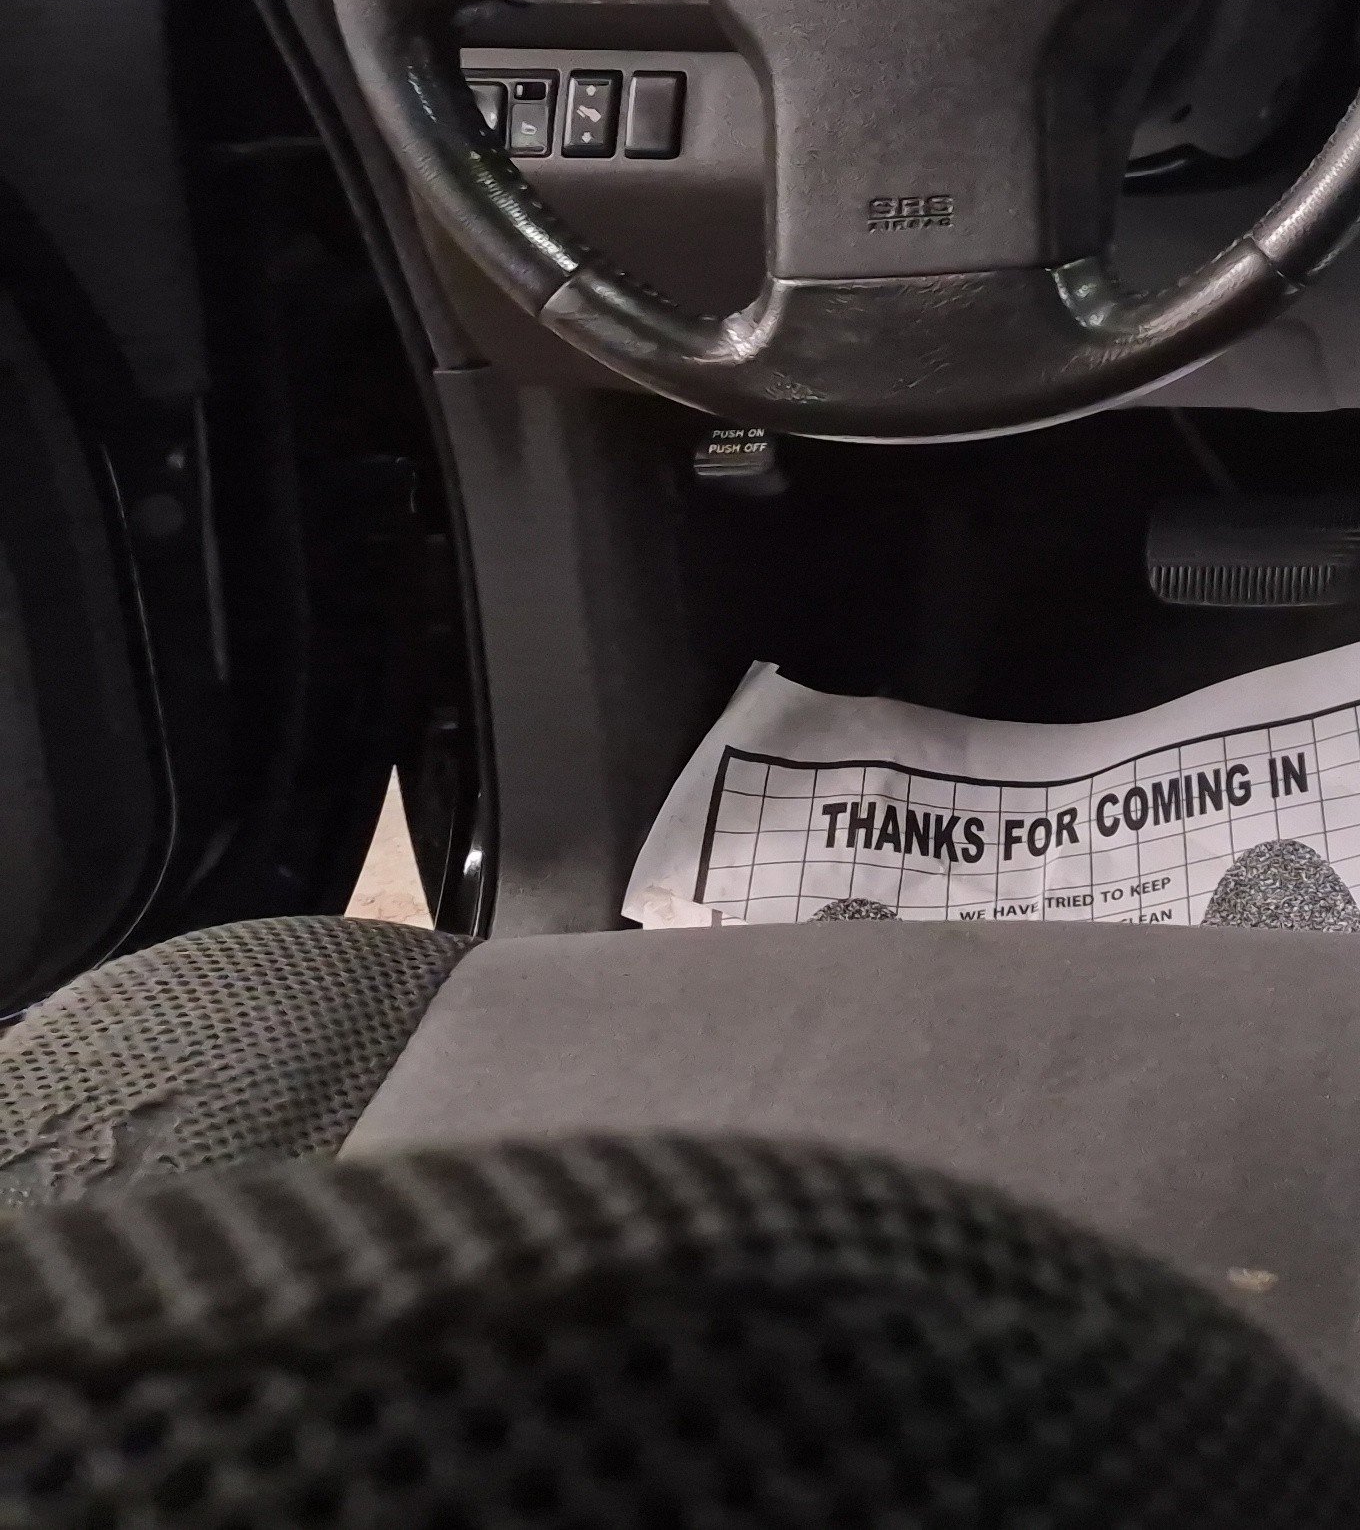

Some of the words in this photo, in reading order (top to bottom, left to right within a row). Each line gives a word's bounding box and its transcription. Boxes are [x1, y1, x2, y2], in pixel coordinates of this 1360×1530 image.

[708, 444, 741, 454] PUSH
[744, 442, 768, 453] OFF
[712, 429, 744, 439] PUSH
[747, 428, 765, 438] ON
[820, 800, 986, 865] THANKS
[1002, 806, 1080, 863] FOR
[1095, 762, 1253, 838] COMING
[1267, 751, 1310, 799] IN
[959, 909, 987, 922] WE
[992, 900, 1040, 919] HAVE
[1044, 892, 1094, 911] TRIED
[1100, 886, 1125, 905] TO
[1129, 875, 1172, 897] KEEP
